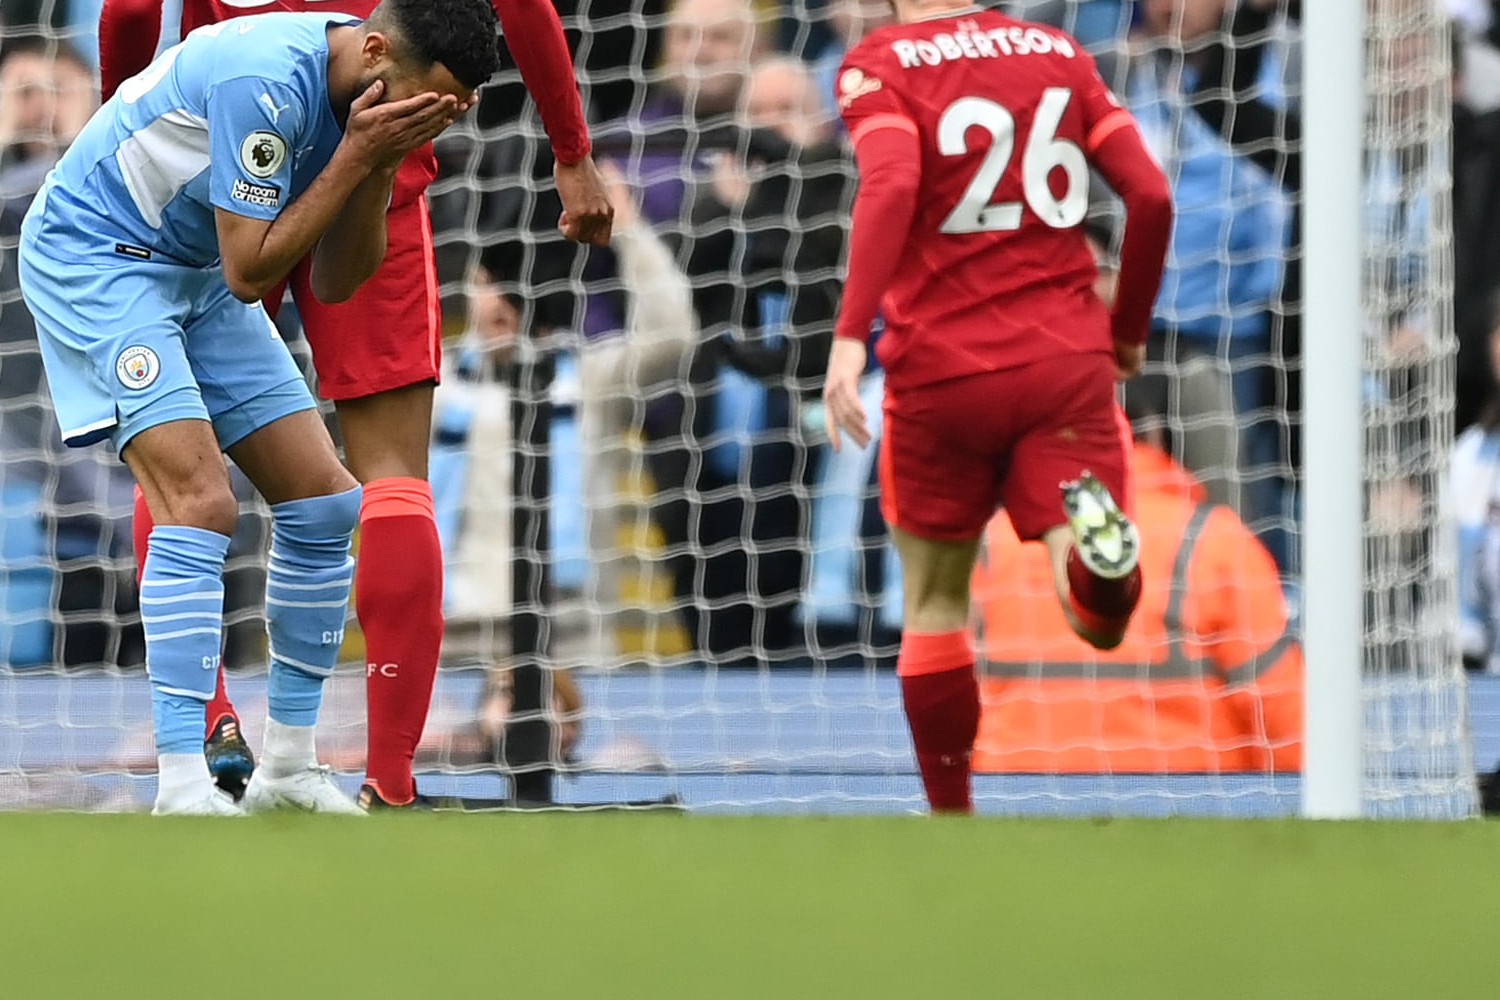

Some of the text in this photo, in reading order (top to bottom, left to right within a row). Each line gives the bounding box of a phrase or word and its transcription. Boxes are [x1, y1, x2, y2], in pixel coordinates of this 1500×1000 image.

[892, 29, 1075, 68] ROBERTSON
[937, 87, 1089, 234] 26
[234, 179, 276, 197] No room
